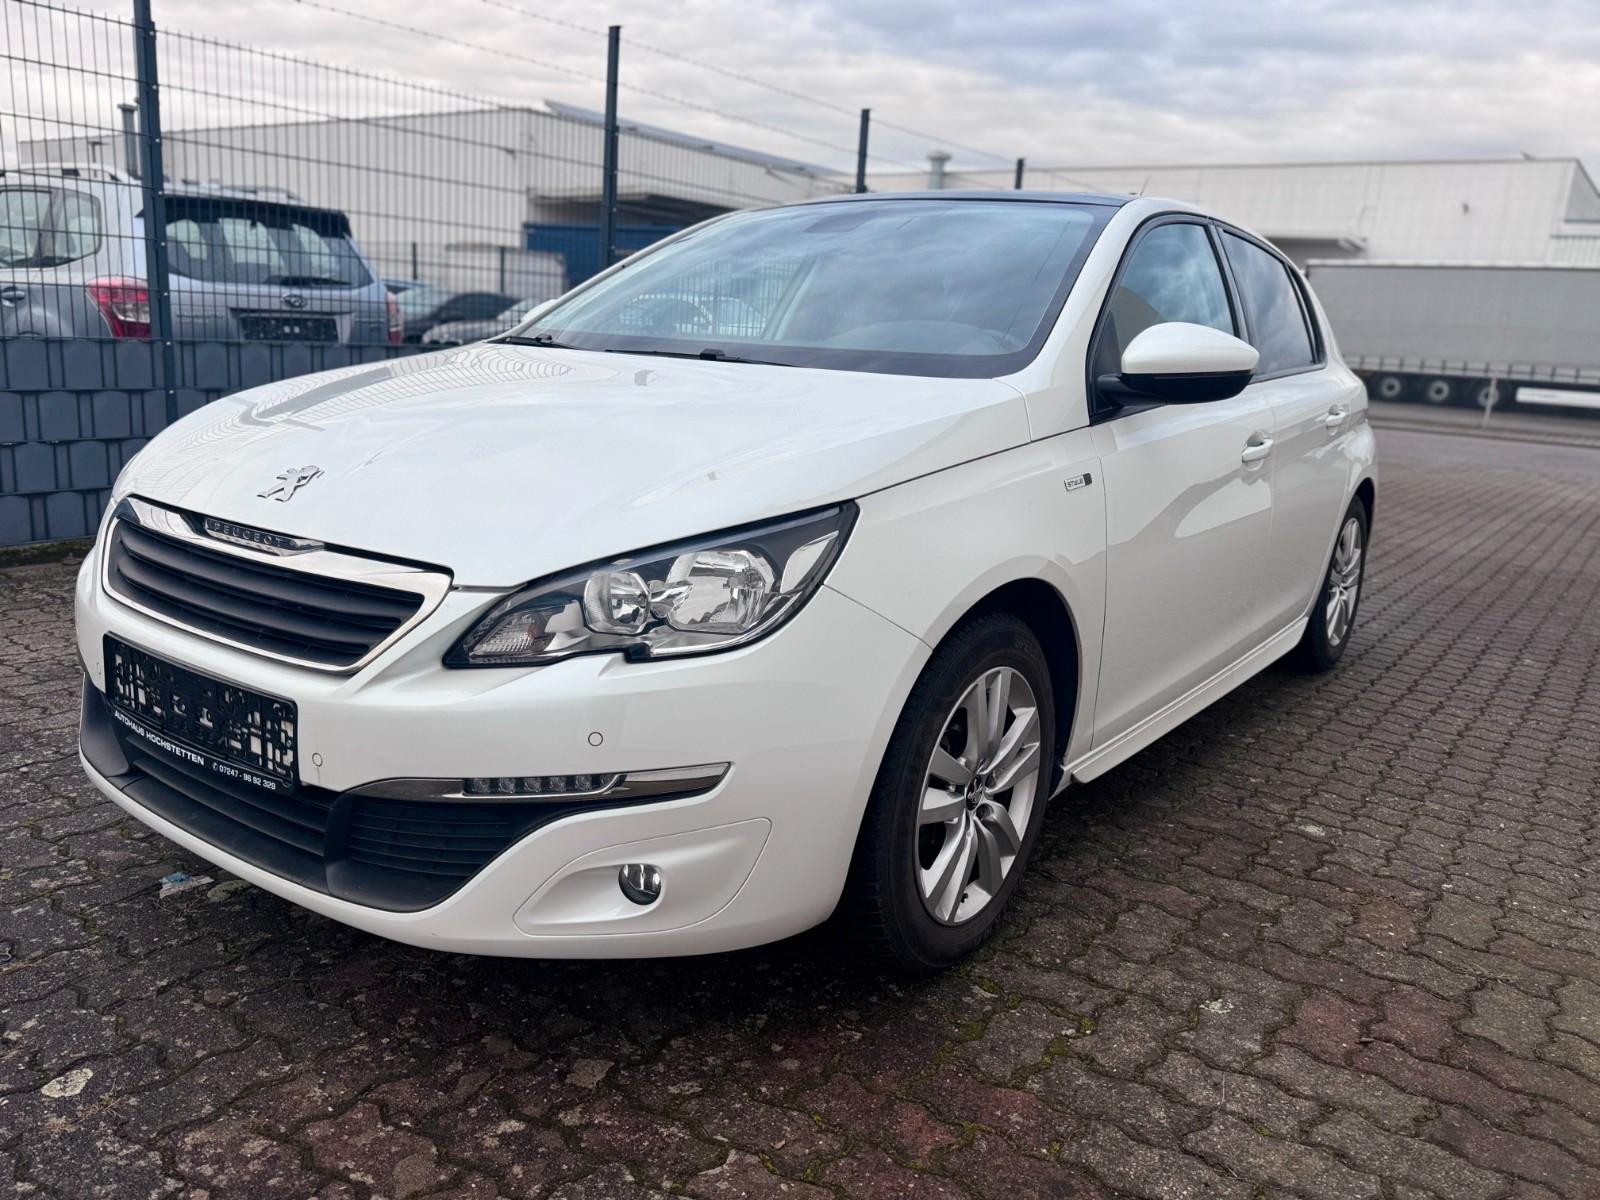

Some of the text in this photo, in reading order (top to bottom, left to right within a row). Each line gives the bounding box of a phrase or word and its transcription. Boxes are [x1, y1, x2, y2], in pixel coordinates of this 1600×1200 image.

[214, 521, 283, 547] PEUGEOT
[114, 709, 205, 765] AUTOHAUS HOCHSTETTEN
[218, 764, 239, 778] 07247
